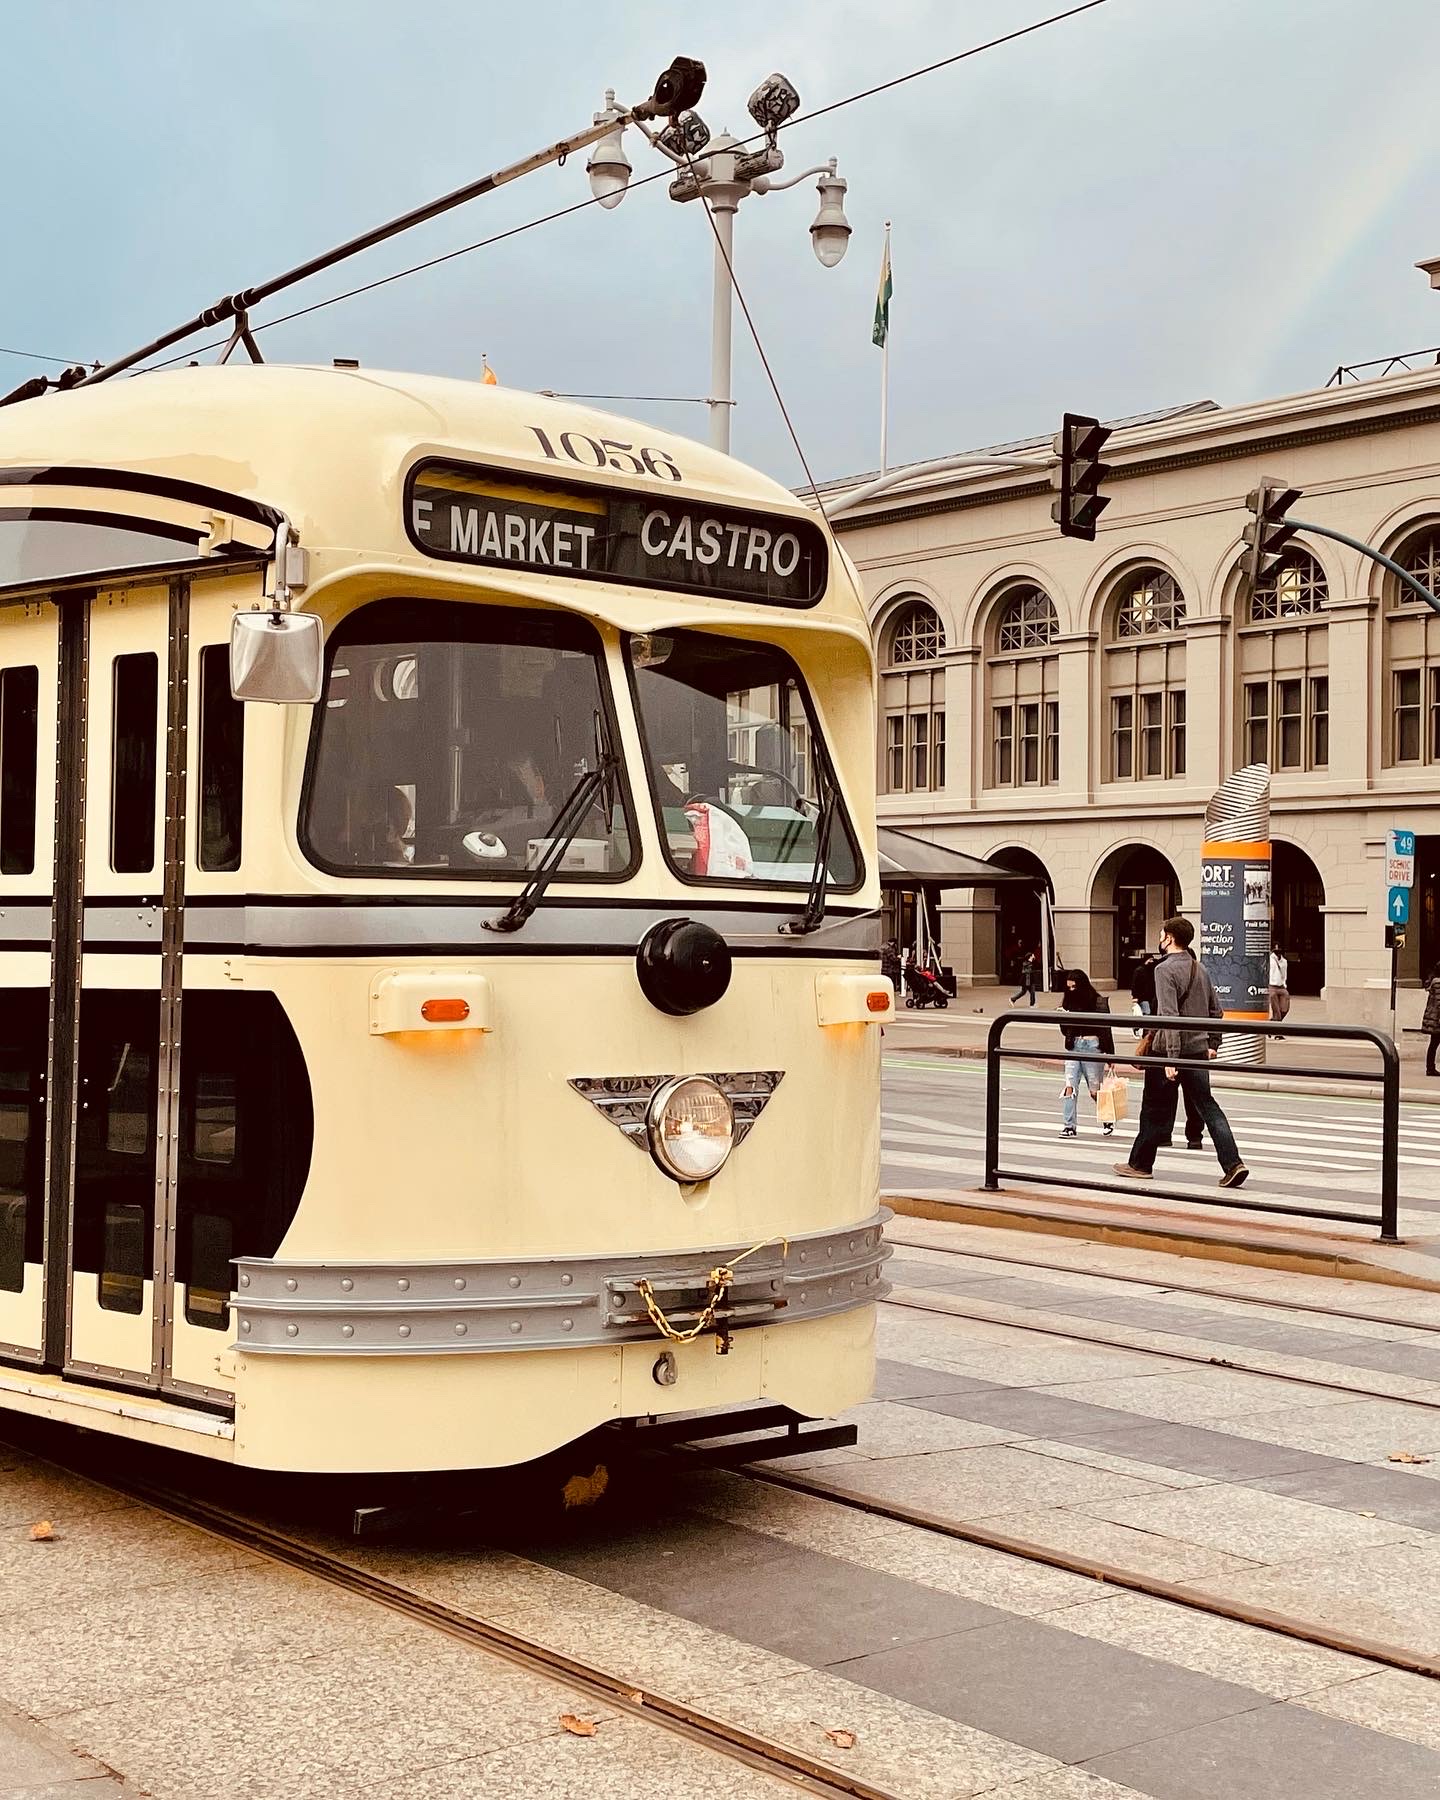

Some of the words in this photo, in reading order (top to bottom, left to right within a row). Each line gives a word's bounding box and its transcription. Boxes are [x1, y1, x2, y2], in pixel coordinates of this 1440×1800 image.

[524, 424, 683, 482] 1056
[412, 499, 433, 537] F
[449, 504, 596, 571] MARKET
[640, 508, 801, 577] CASTRO
[1400, 836, 1413, 850] 49
[1388, 870, 1411, 881] DRIVE
[1389, 858, 1411, 870] SCENIC
